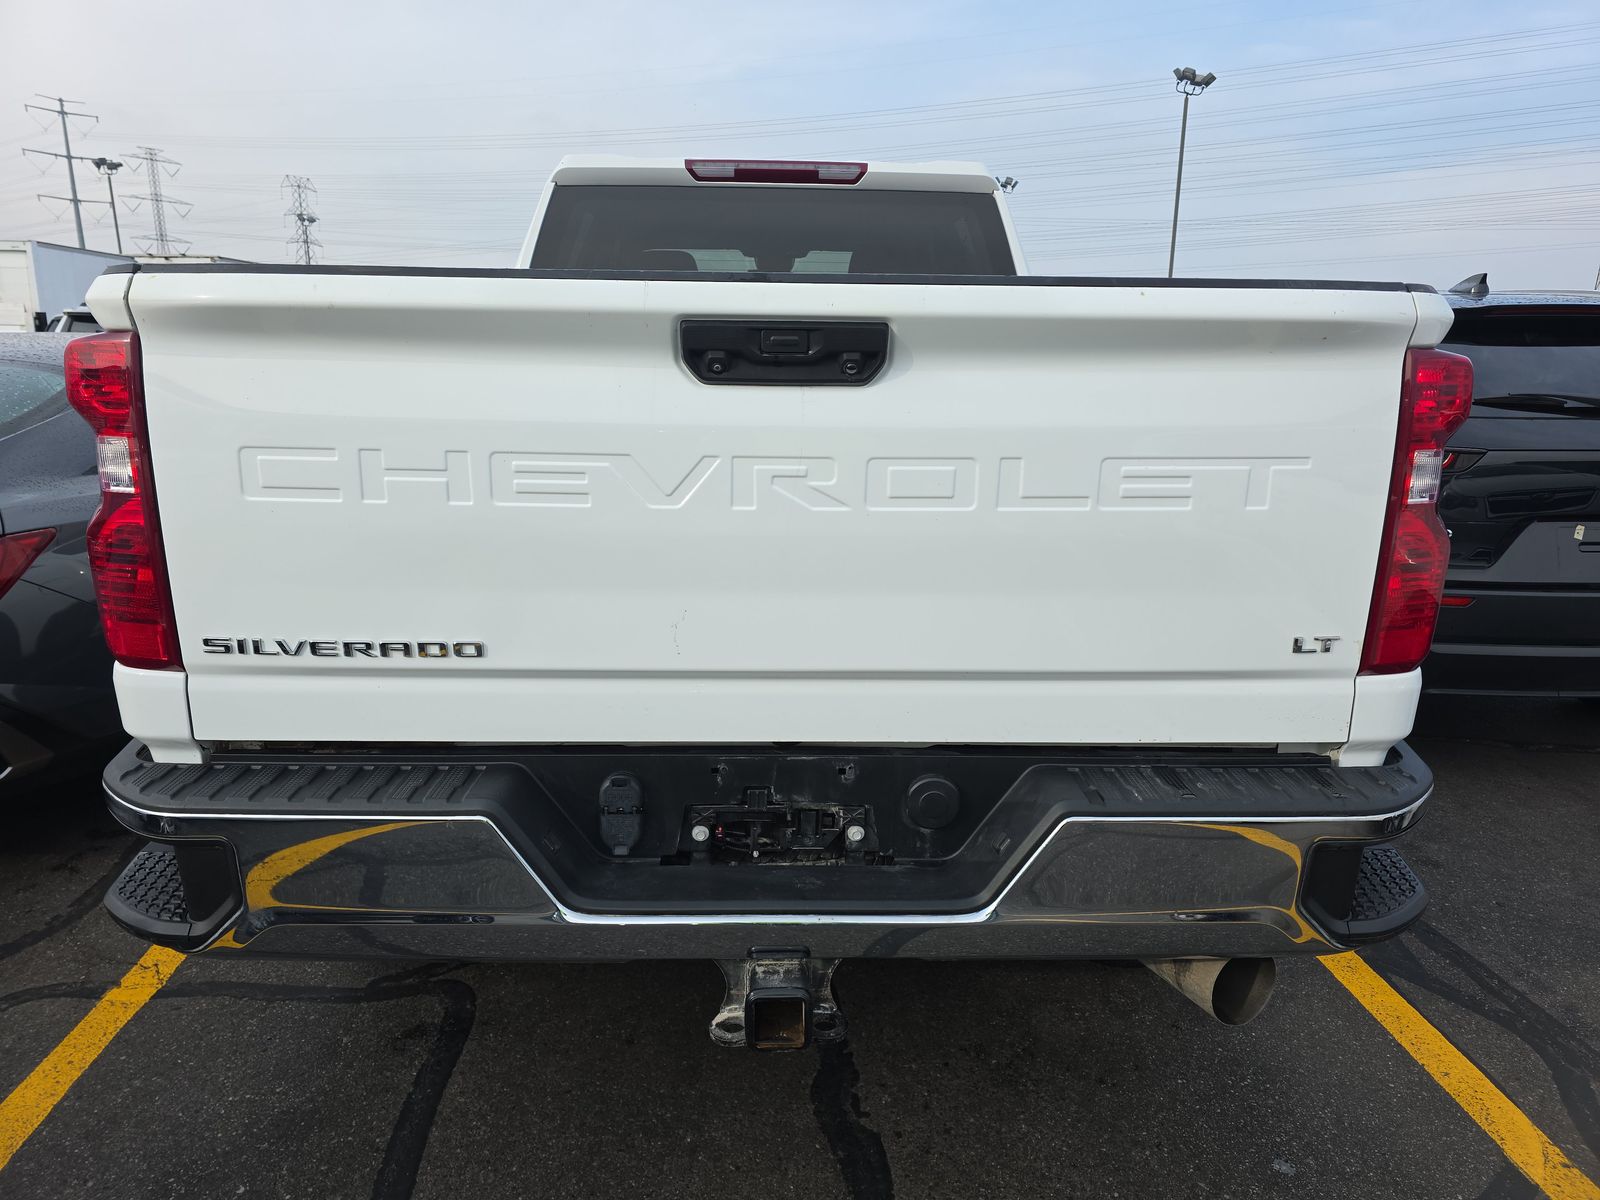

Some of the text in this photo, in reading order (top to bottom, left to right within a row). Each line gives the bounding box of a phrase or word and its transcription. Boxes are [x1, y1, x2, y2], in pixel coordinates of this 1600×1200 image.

[239, 446, 1312, 512] CHEVROLET
[203, 637, 486, 658] SILVERADO
[1292, 636, 1341, 654] LT
